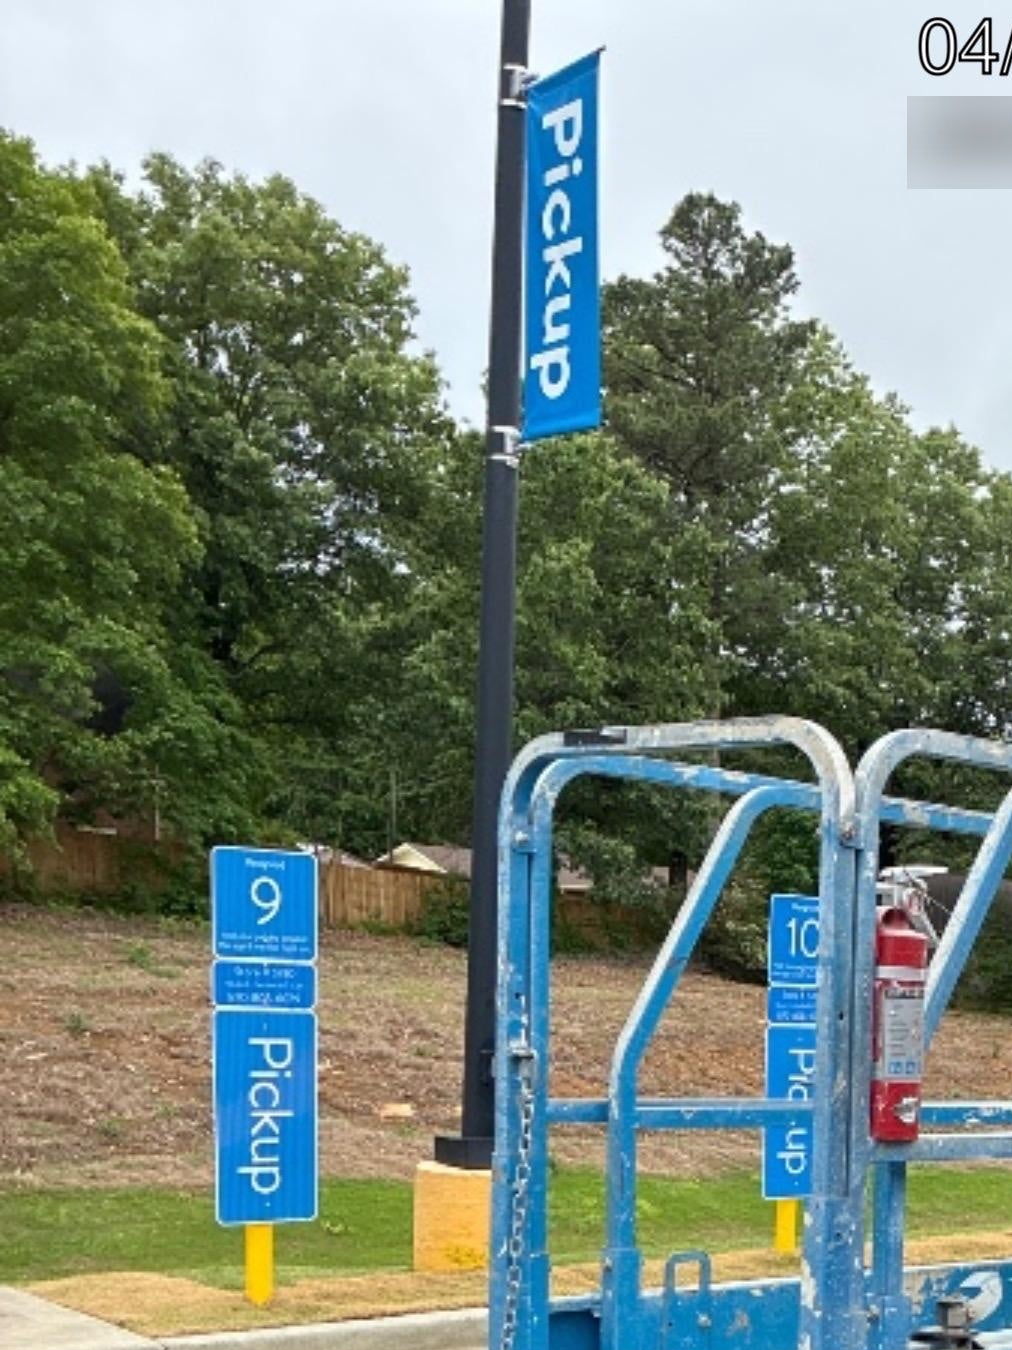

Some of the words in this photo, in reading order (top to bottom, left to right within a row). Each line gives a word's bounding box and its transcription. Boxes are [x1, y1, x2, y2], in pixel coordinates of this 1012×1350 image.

[530, 98, 583, 399] Pickup
[250, 875, 282, 926] 9
[786, 917, 820, 959] 10
[237, 1036, 294, 1195] Pickup
[776, 1048, 817, 1175] Picup
